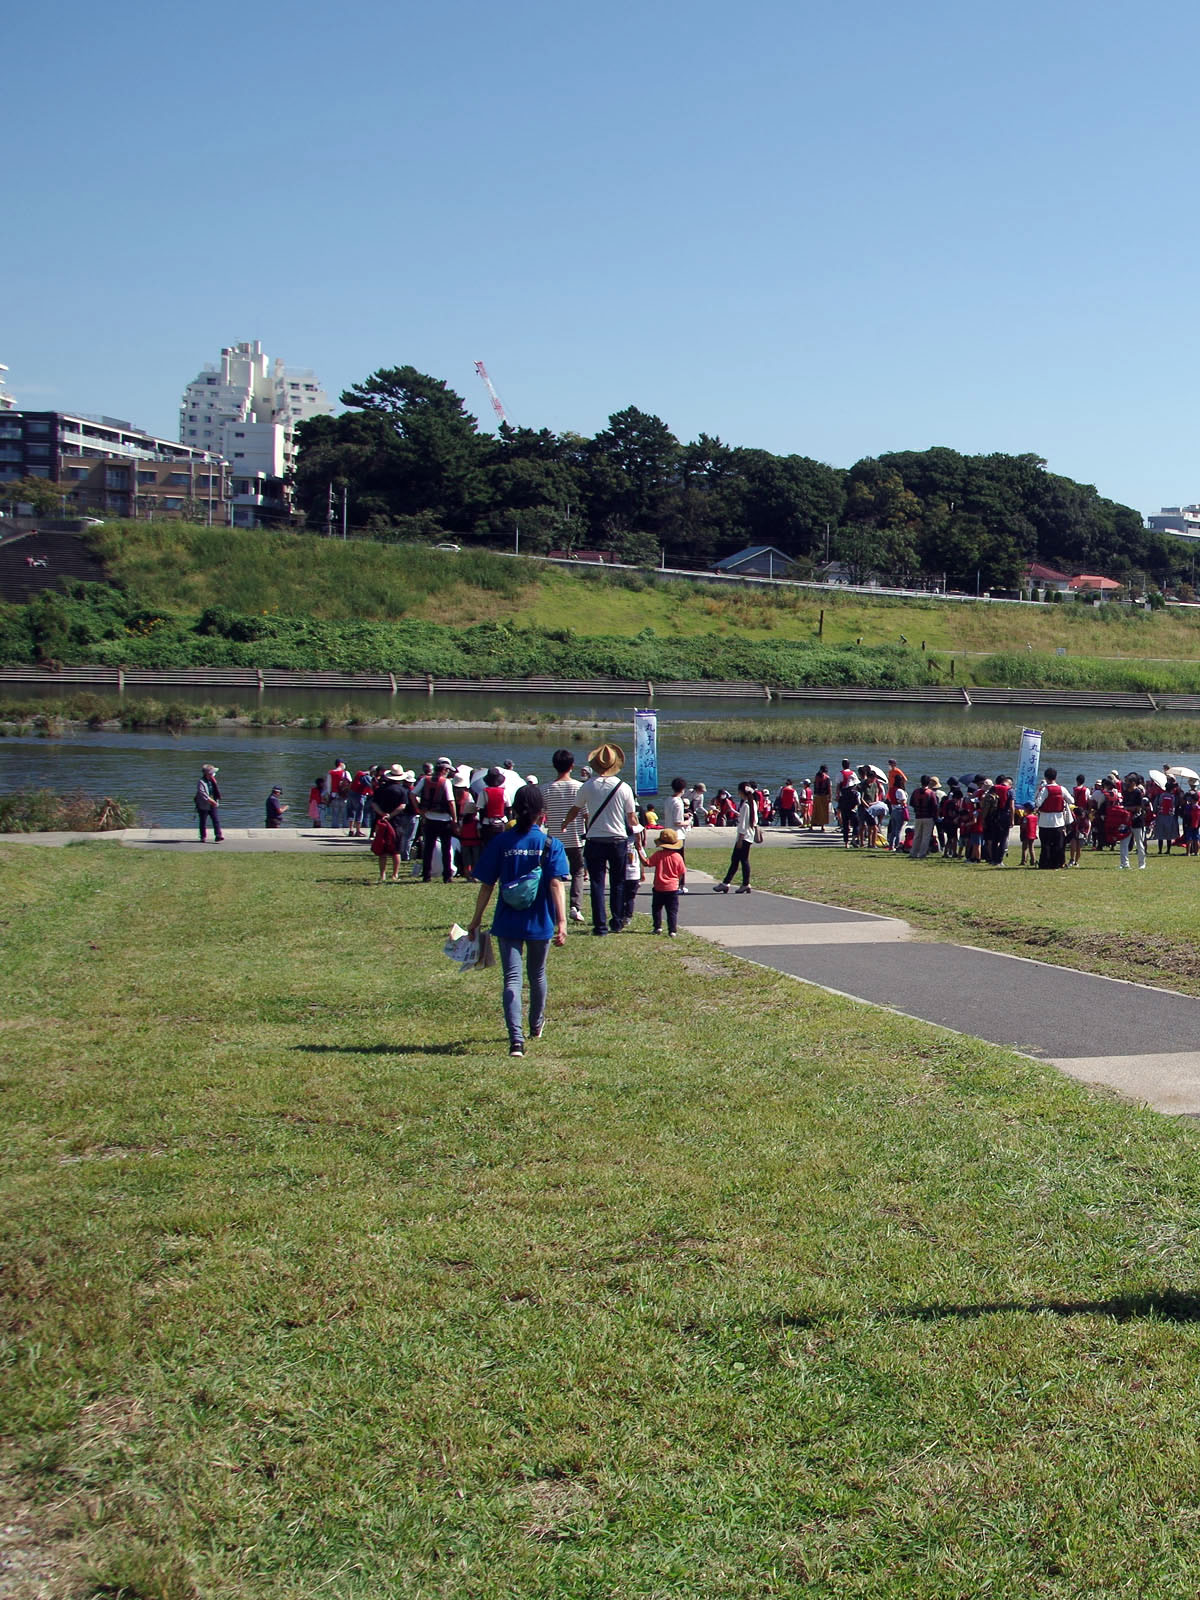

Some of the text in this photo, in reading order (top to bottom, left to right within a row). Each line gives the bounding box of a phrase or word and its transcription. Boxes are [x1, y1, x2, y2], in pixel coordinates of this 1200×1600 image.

[644, 723, 656, 781] 丸子の渡し
